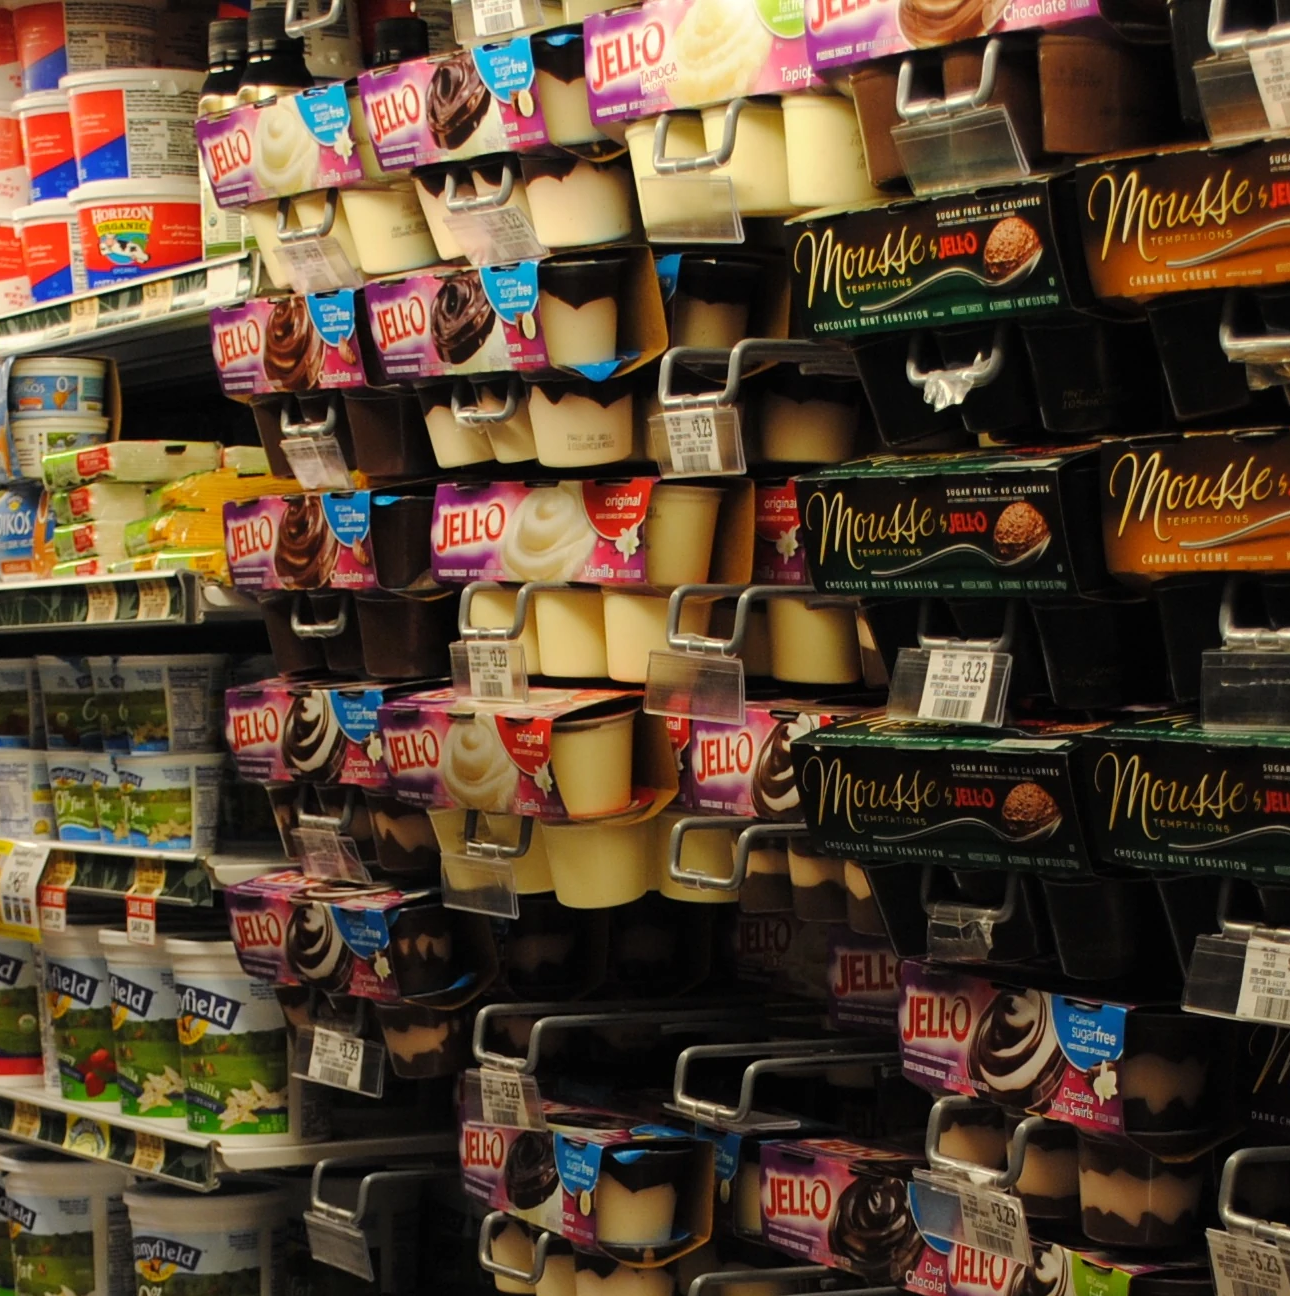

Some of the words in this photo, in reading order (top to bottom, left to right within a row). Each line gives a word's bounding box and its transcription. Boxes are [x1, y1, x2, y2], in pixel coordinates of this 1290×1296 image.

[91, 205, 153, 221] HORIZON
[96, 220, 148, 234] ORGANIC
[1150, 228, 1234, 246] TEMPTATIONS
[845, 276, 913, 295] TEMPTATIONS
[1129, 272, 1178, 287] CARAMEL
[813, 317, 858, 333] CHOCOLATE
[436, 502, 507, 555] JELL-O
[1166, 513, 1250, 527] TEMPTATIONS
[1141, 551, 1191, 565] CARAMEL
[961, 658, 987, 684] $3.23
[903, 996, 972, 1042] JELL-O
[338, 1042, 361, 1062] $3.23
[765, 1175, 831, 1221] JELL-O
[991, 1200, 1018, 1228] $3.23
[1247, 1249, 1282, 1276] $3.23
